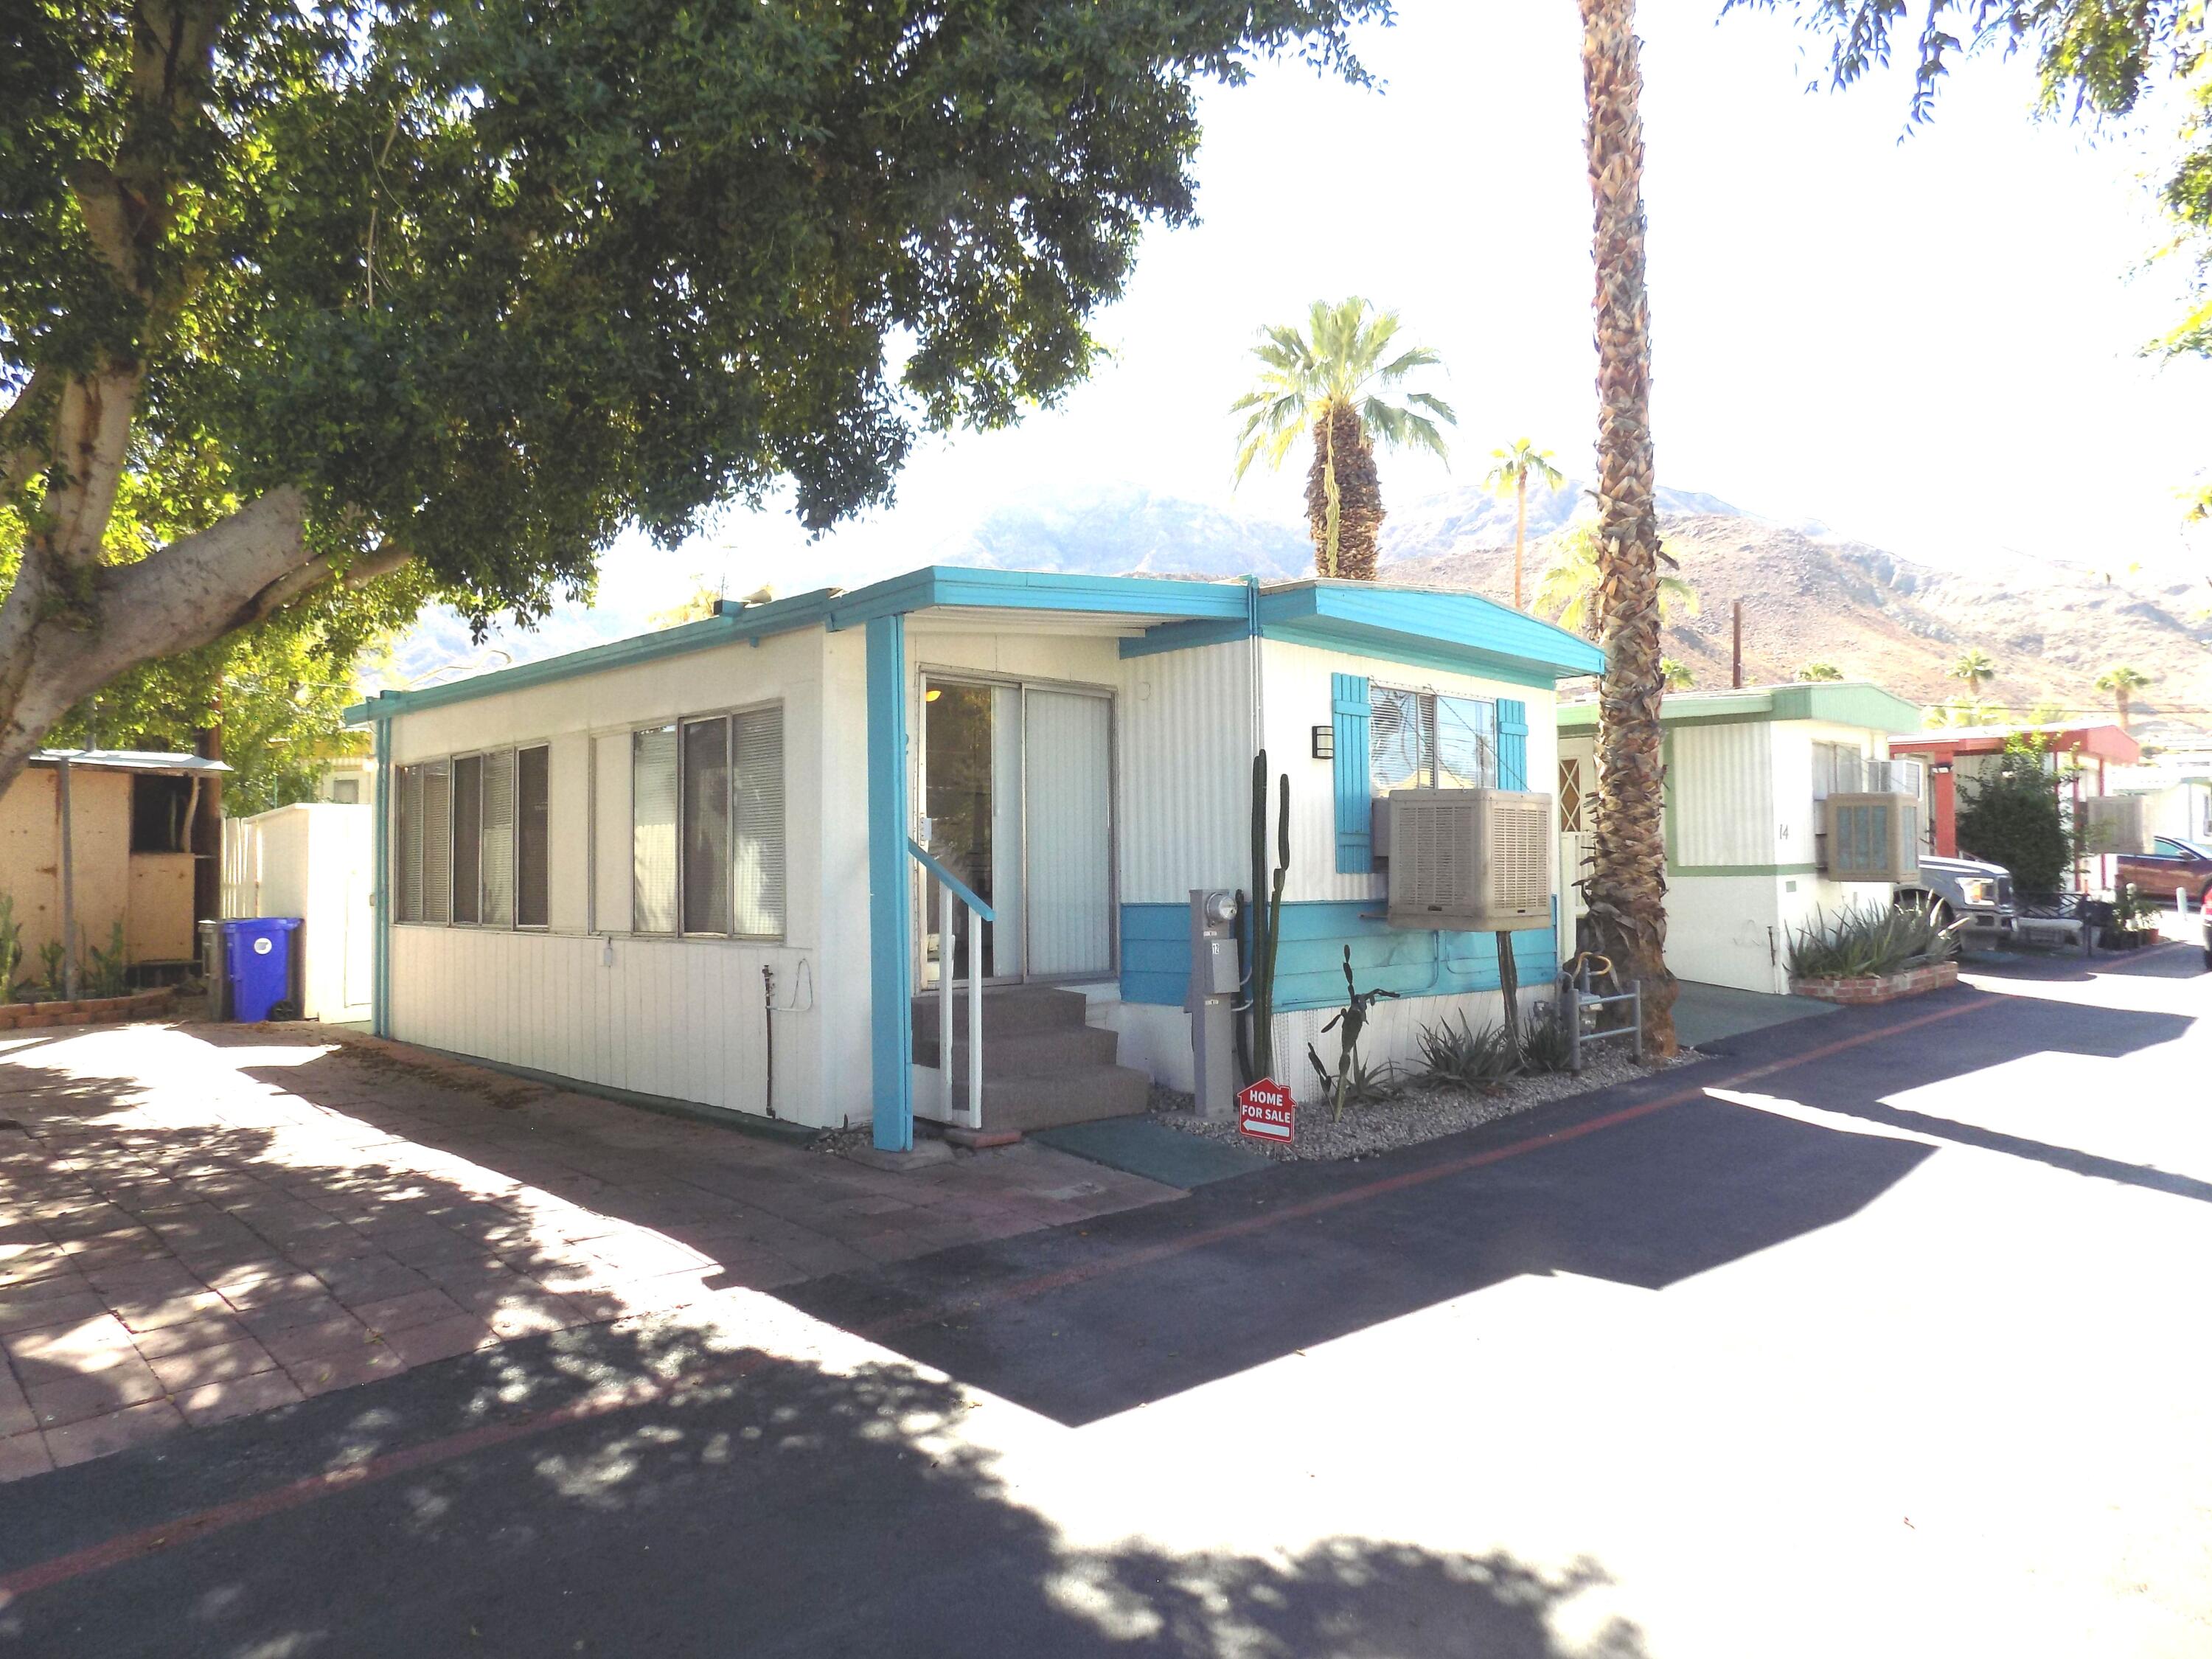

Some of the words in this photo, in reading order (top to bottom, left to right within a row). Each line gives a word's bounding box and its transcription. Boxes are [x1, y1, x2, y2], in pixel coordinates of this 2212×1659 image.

[1780, 824, 1788, 840] 14
[1213, 944, 1219, 954] 12
[1250, 1090, 1283, 1106] HOME
[1242, 1105, 1262, 1119] FOR
[1265, 1109, 1290, 1123] SALE
